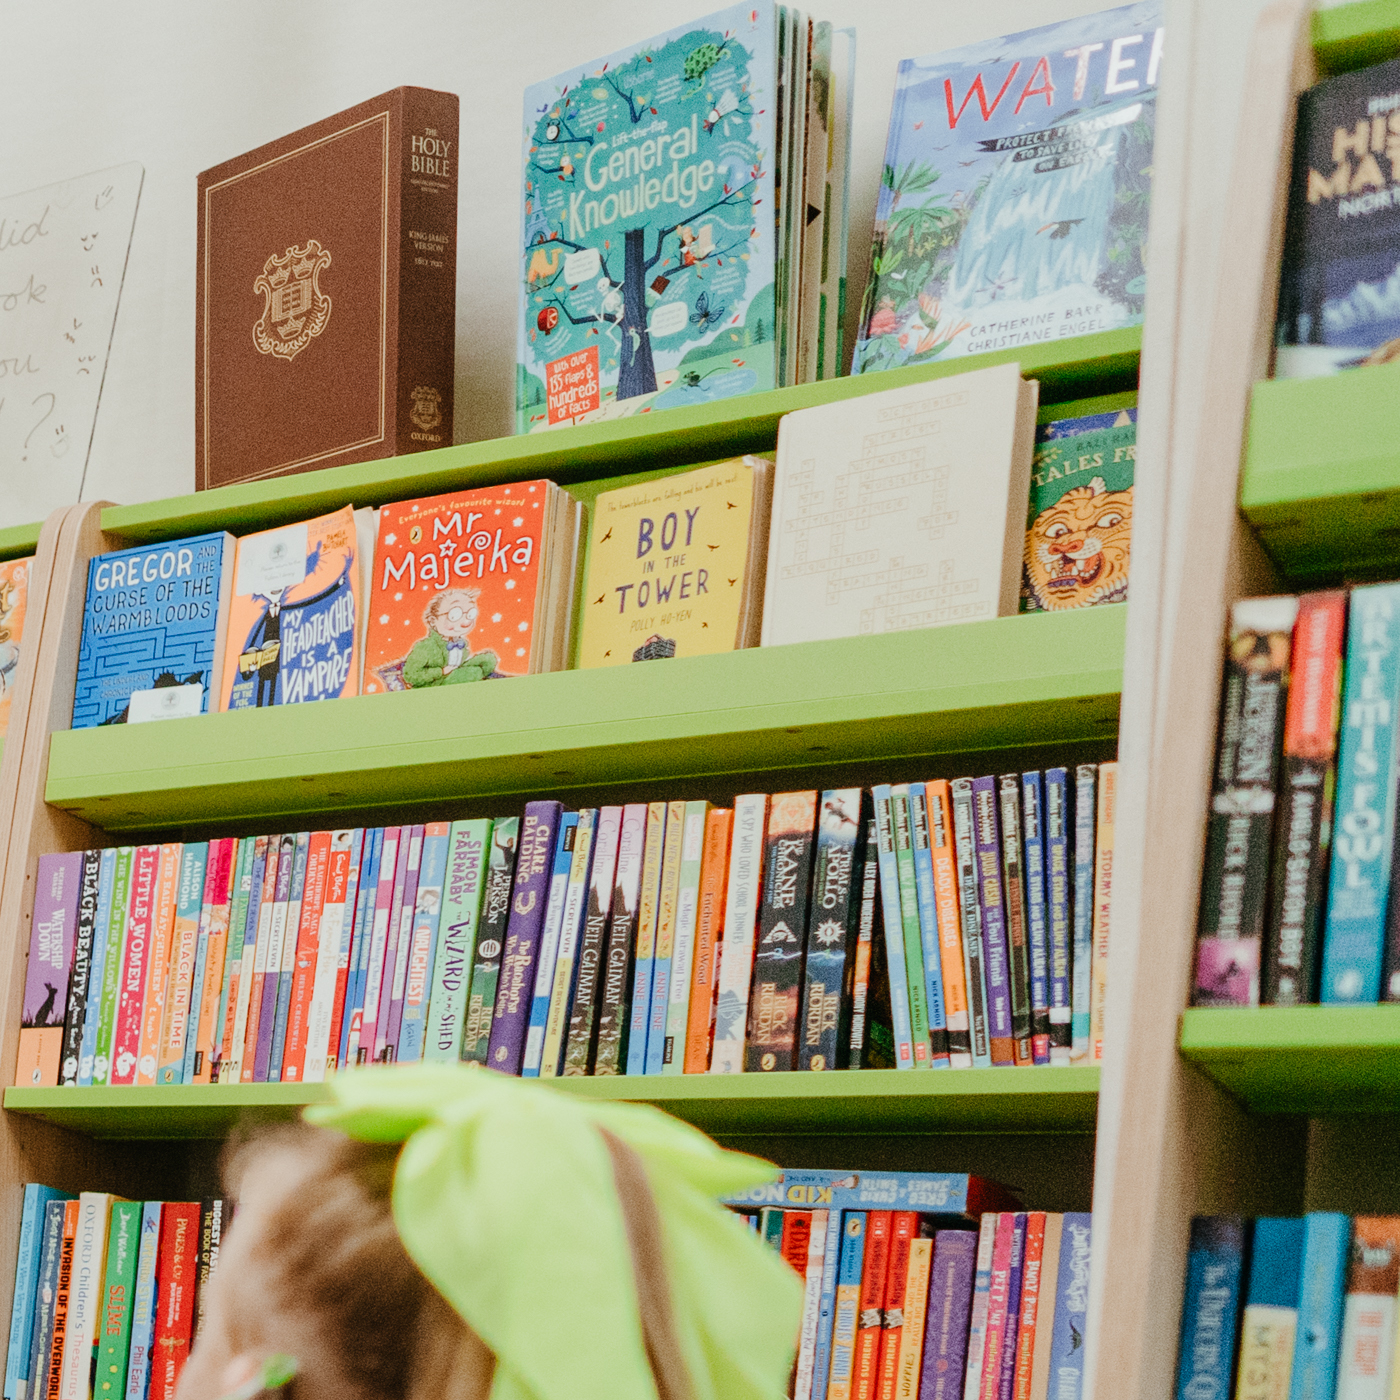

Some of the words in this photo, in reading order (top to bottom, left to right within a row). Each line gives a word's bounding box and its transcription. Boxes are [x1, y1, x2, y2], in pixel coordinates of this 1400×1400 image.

[411, 135, 451, 157] HOLY
[584, 113, 698, 192] General
[996, 131, 1051, 150] PROTECT
[410, 155, 450, 179] BIBLE
[569, 160, 715, 241] Knowledge
[408, 230, 427, 241] KING
[428, 231, 449, 245] JAMES
[413, 241, 444, 254] VERSION
[967, 326, 1052, 353] CHRISTIANE
[1058, 318, 1106, 336] ENGEL
[969, 311, 1056, 338] CATHERINE
[1064, 303, 1104, 322] BARR
[550, 373, 563, 393] 135
[565, 369, 585, 385] flaps
[586, 363, 594, 379] &
[571, 352, 588, 368] over
[549, 379, 597, 410] hundreds
[558, 405, 567, 418] of
[570, 399, 590, 415] facts
[410, 431, 441, 443] OXFORD
[1033, 452, 1104, 487] TALES
[450, 497, 493, 510] favourite
[495, 498, 526, 507] wizard
[326, 530, 346, 543] PAMELA
[433, 512, 483, 541] Mr
[636, 506, 701, 559] BOY
[95, 548, 193, 592] GREGOR
[197, 545, 217, 559] AND
[195, 560, 215, 574] THE
[381, 528, 533, 590] Majeika
[642, 560, 655, 574] IN
[665, 553, 687, 569] THE
[93, 586, 149, 615] CURSE
[155, 581, 177, 603] OF
[183, 576, 214, 598] THE
[615, 568, 710, 614] TOWER
[92, 600, 212, 636] WARMBLOODS
[282, 590, 355, 666] HEADTEACHER
[283, 609, 304, 628] MY
[630, 617, 655, 633] POLLY
[660, 609, 693, 626] HO-YEN
[302, 651, 315, 667] IS
[327, 640, 338, 658] A
[282, 647, 353, 705] VAMPIRE
[448, 830, 471, 905] FARNABY
[463, 840, 482, 894] SIMON
[516, 815, 539, 885] BALDING
[532, 825, 550, 875] CLARE
[80, 861, 98, 922] BLACK
[135, 856, 153, 919] LITTLE
[179, 852, 194, 910] HAMMOND
[190, 861, 201, 900] ALISON
[1101, 850, 1113, 899] STORMY
[37, 922, 51, 961] DOWN
[50, 908, 65, 970] WATERSHIP
[586, 914, 605, 947] NEIL
[74, 927, 92, 995] BEAUTY
[127, 922, 146, 992] WOMEN
[178, 930, 194, 981] BLACK
[175, 985, 185, 1004] IN
[576, 949, 599, 1005] GAIMAN
[635, 971, 647, 1000] ANNE
[170, 1009, 184, 1047] TIME
[438, 1013, 457, 1051] SHED
[632, 1004, 644, 1031] FINE
[757, 982, 776, 1045] RIORDAN
[83, 1204, 96, 1265] OXFORD
[59, 1237, 75, 1291] INVASION
[106, 1285, 126, 1337] SLIME
[69, 1333, 85, 1396] Thesaurus
[860, 1333, 873, 1383] SUPREME
[130, 1367, 143, 1394] Earle
